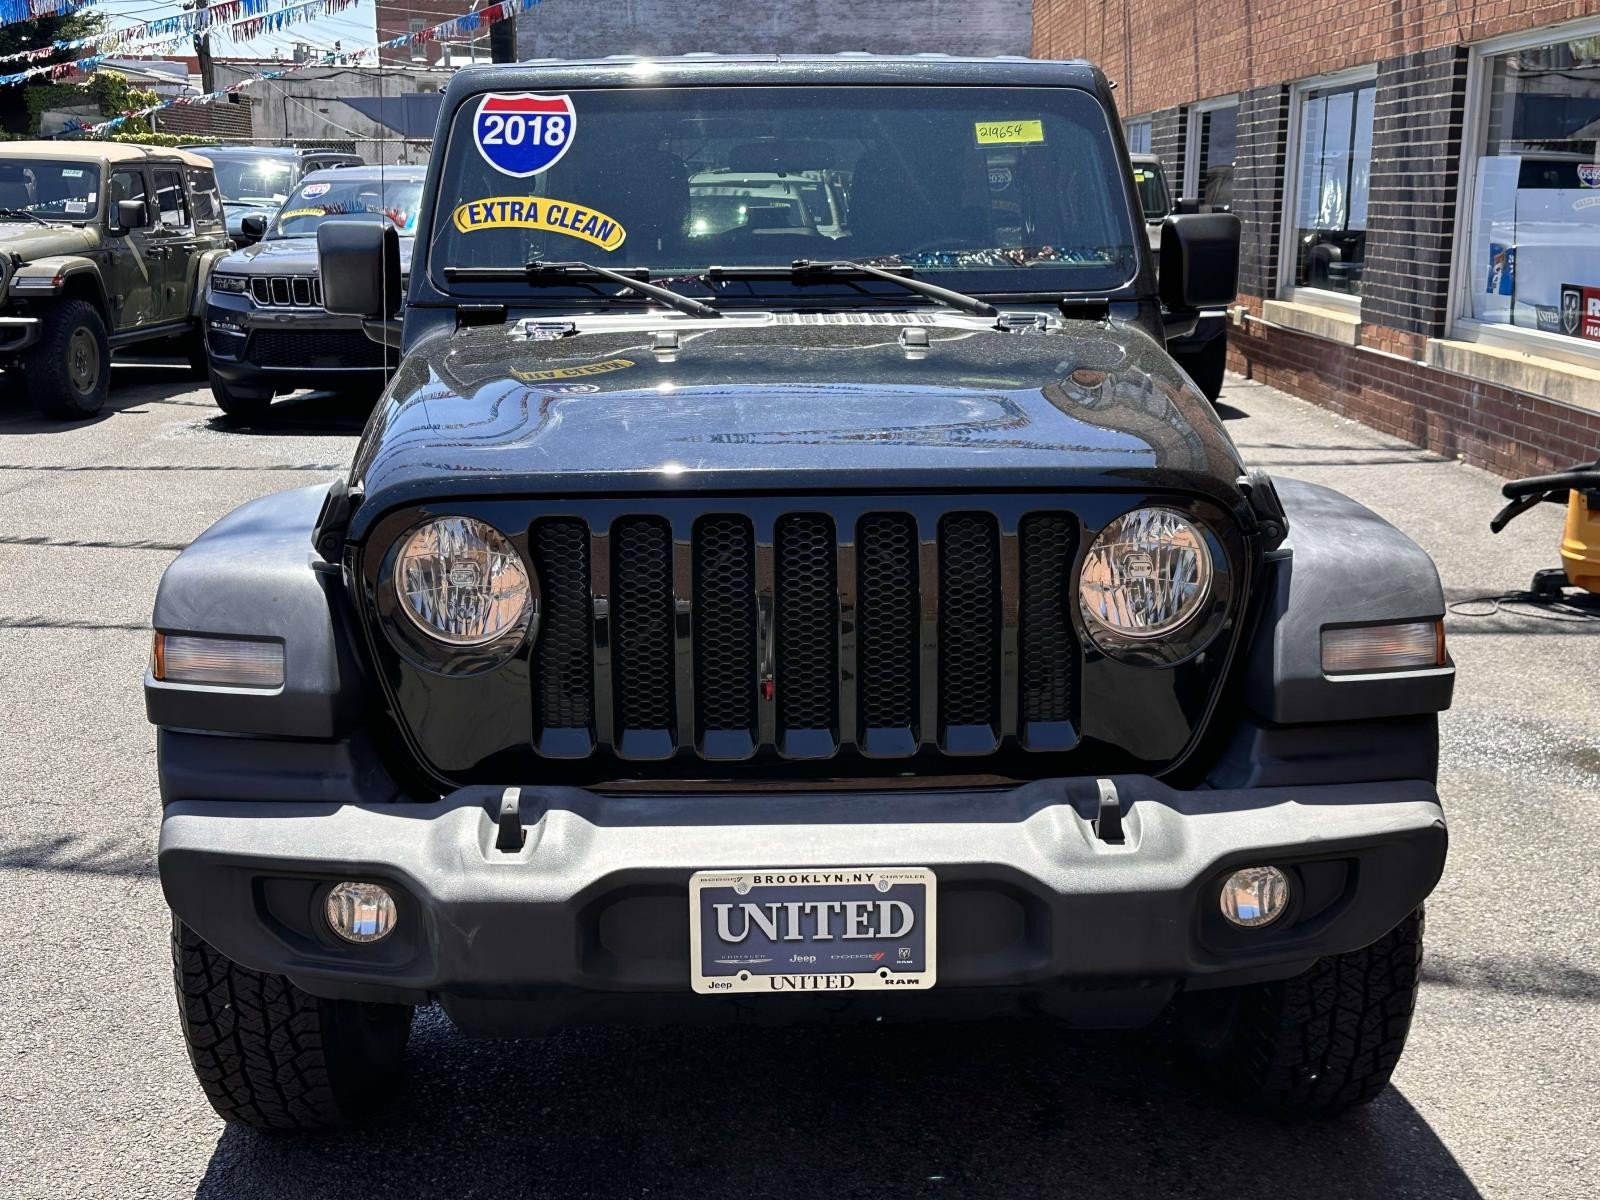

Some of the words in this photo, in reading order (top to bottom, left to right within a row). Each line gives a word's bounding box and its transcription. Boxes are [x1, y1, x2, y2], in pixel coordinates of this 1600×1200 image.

[482, 115, 566, 146] 2018
[979, 124, 1023, 138] 219654
[467, 201, 538, 225] EXTRA
[546, 205, 617, 242] CLEAN
[712, 900, 915, 943] UNITED
[789, 954, 817, 963] Jeep
[708, 981, 733, 990] Jeep
[768, 974, 855, 990] UNITED
